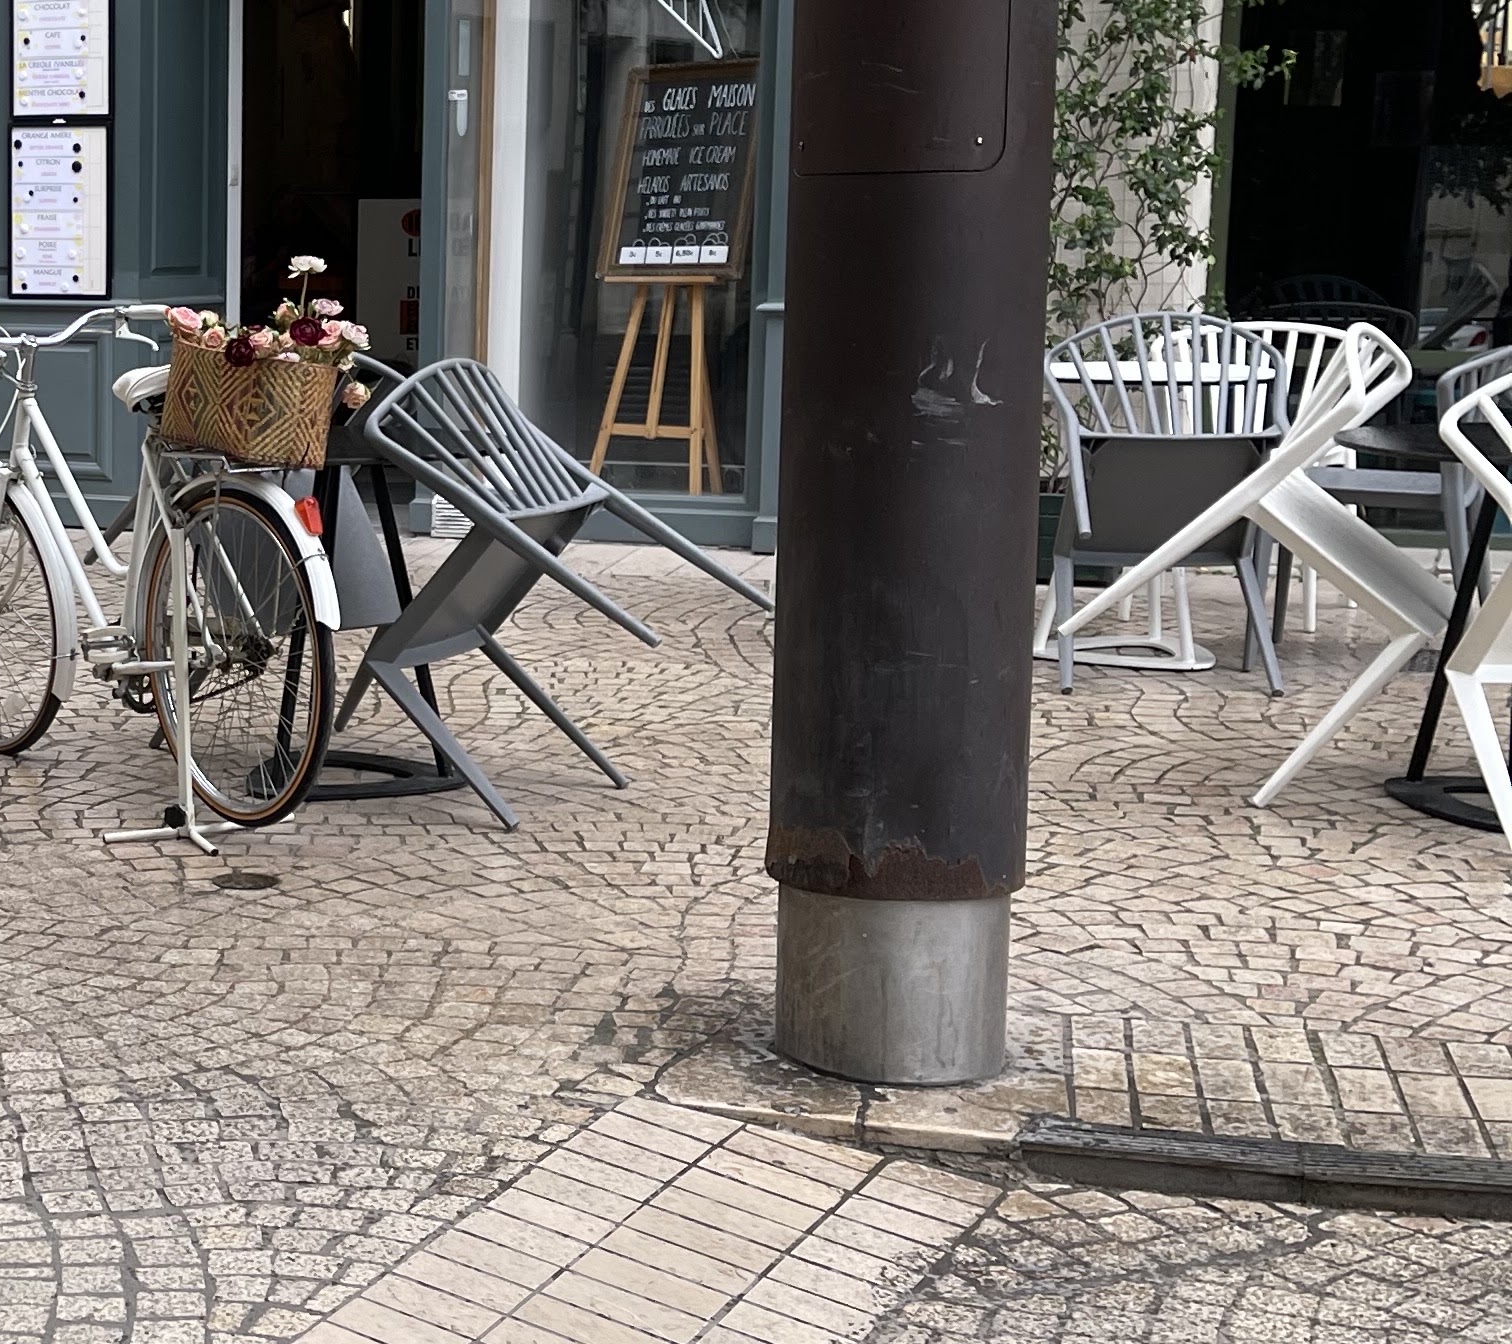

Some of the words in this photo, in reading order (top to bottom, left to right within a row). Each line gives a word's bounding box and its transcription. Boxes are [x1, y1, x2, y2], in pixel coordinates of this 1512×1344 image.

[663, 86, 698, 111] GLACES
[708, 83, 756, 108] MAISON
[709, 111, 749, 136] PLACE
[689, 146, 705, 164] ICE
[706, 146, 736, 164] CREAM
